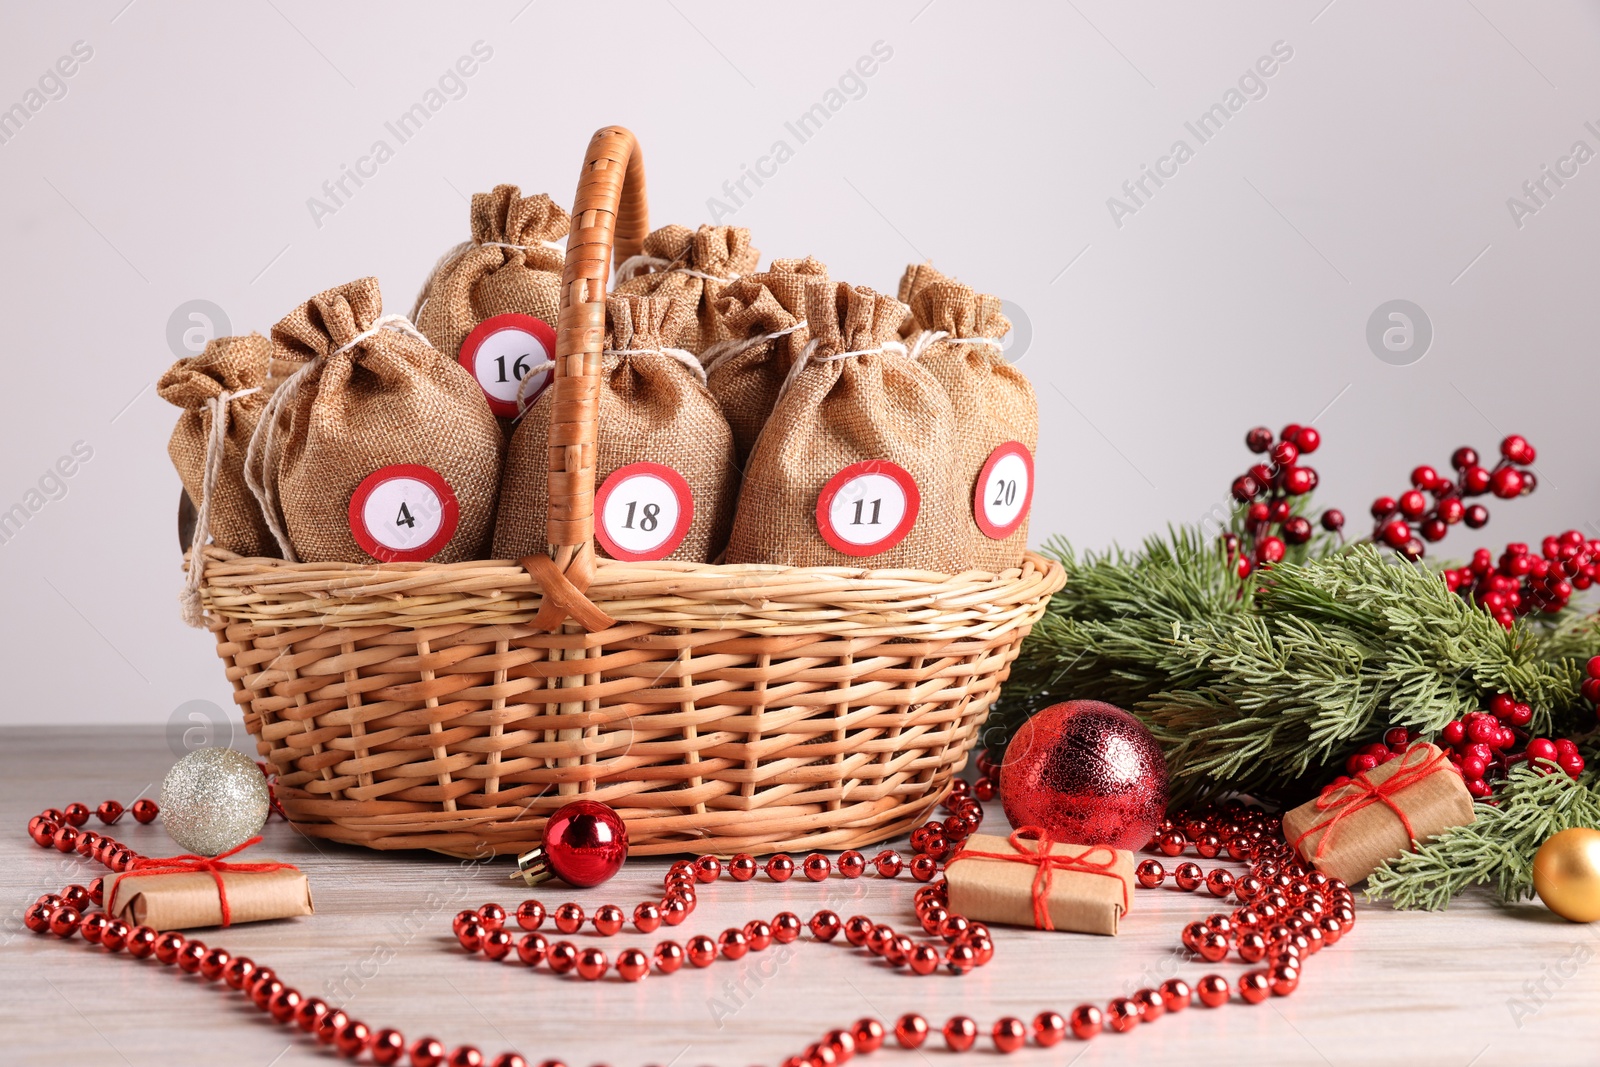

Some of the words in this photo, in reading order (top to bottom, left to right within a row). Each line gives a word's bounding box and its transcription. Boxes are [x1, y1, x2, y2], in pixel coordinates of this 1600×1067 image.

[494, 353, 531, 383] 16
[992, 479, 1016, 507] 20
[396, 501, 415, 529] 4
[621, 501, 661, 532] 18
[850, 498, 882, 525] 11
